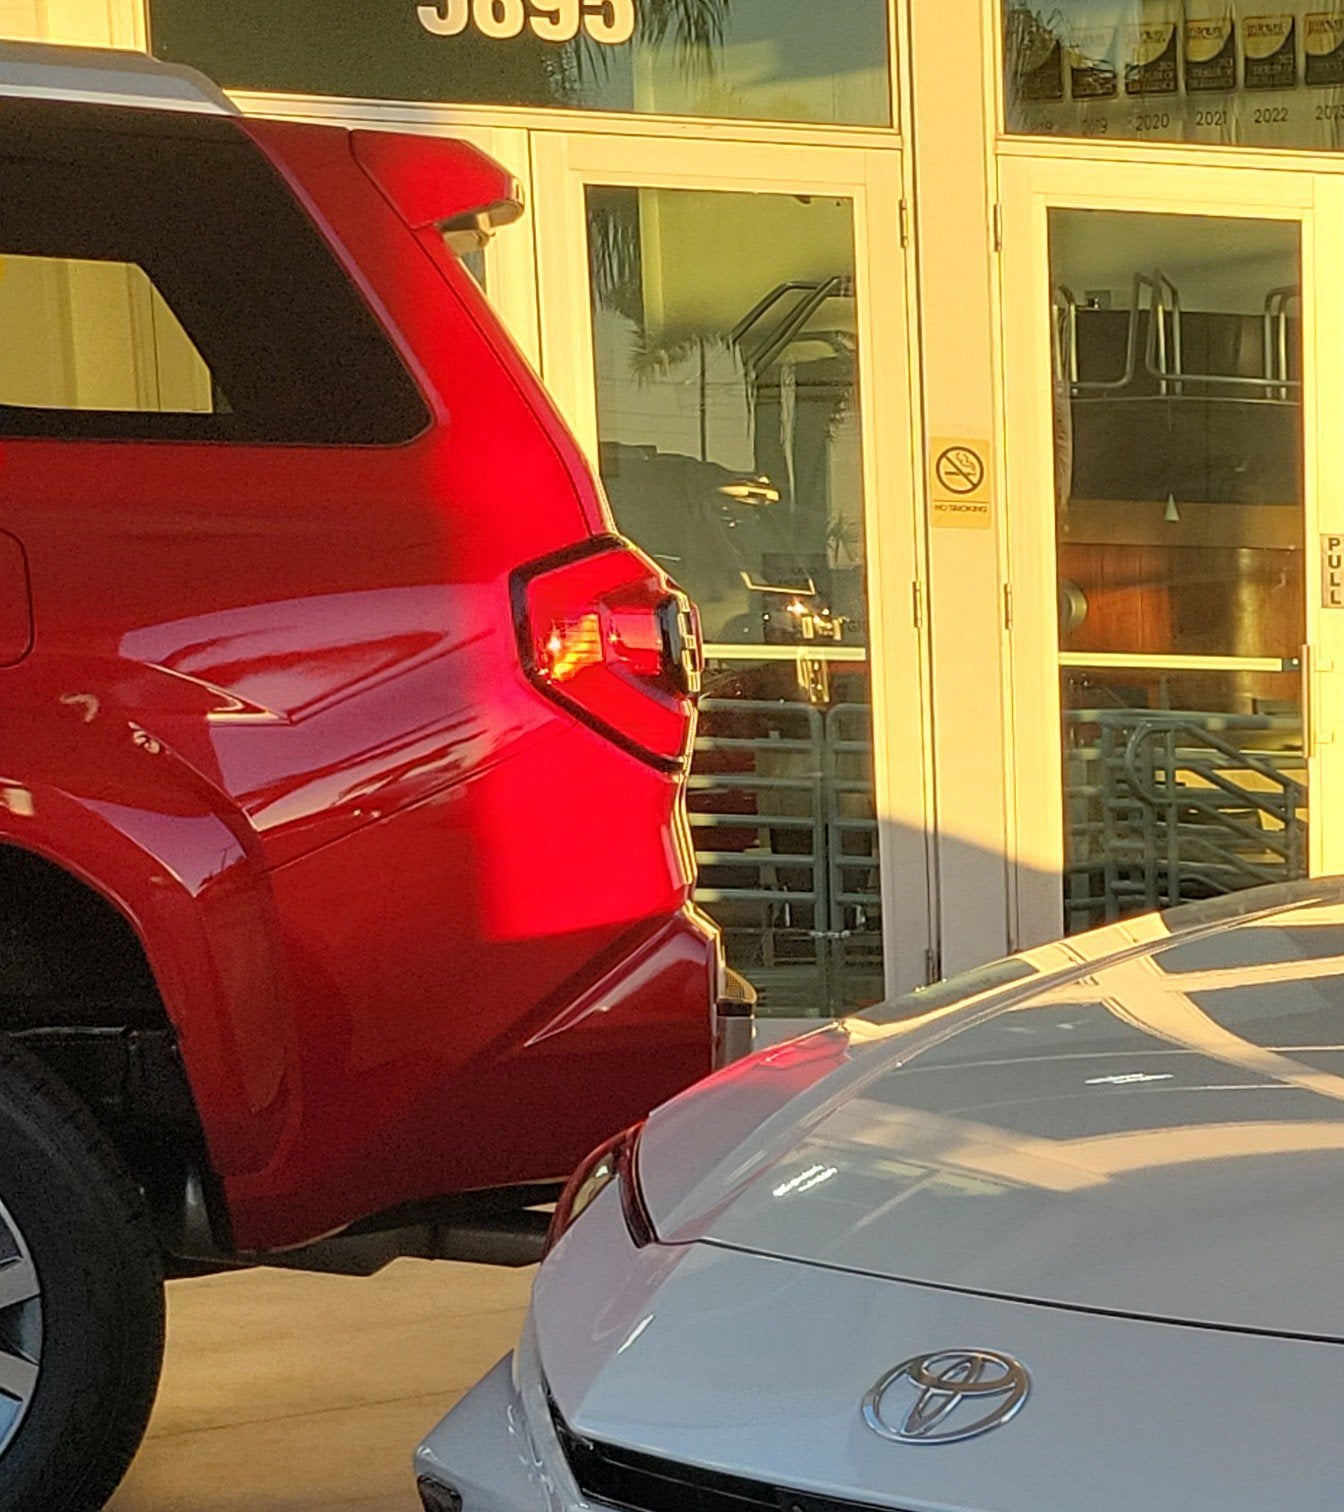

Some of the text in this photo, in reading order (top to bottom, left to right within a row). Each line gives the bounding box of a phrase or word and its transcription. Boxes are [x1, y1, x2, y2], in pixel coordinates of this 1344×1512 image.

[1136, 114, 1169, 131] 2020
[1196, 111, 1228, 126] 2021
[1254, 108, 1289, 124] 2022
[1327, 537, 1342, 605] PULL
